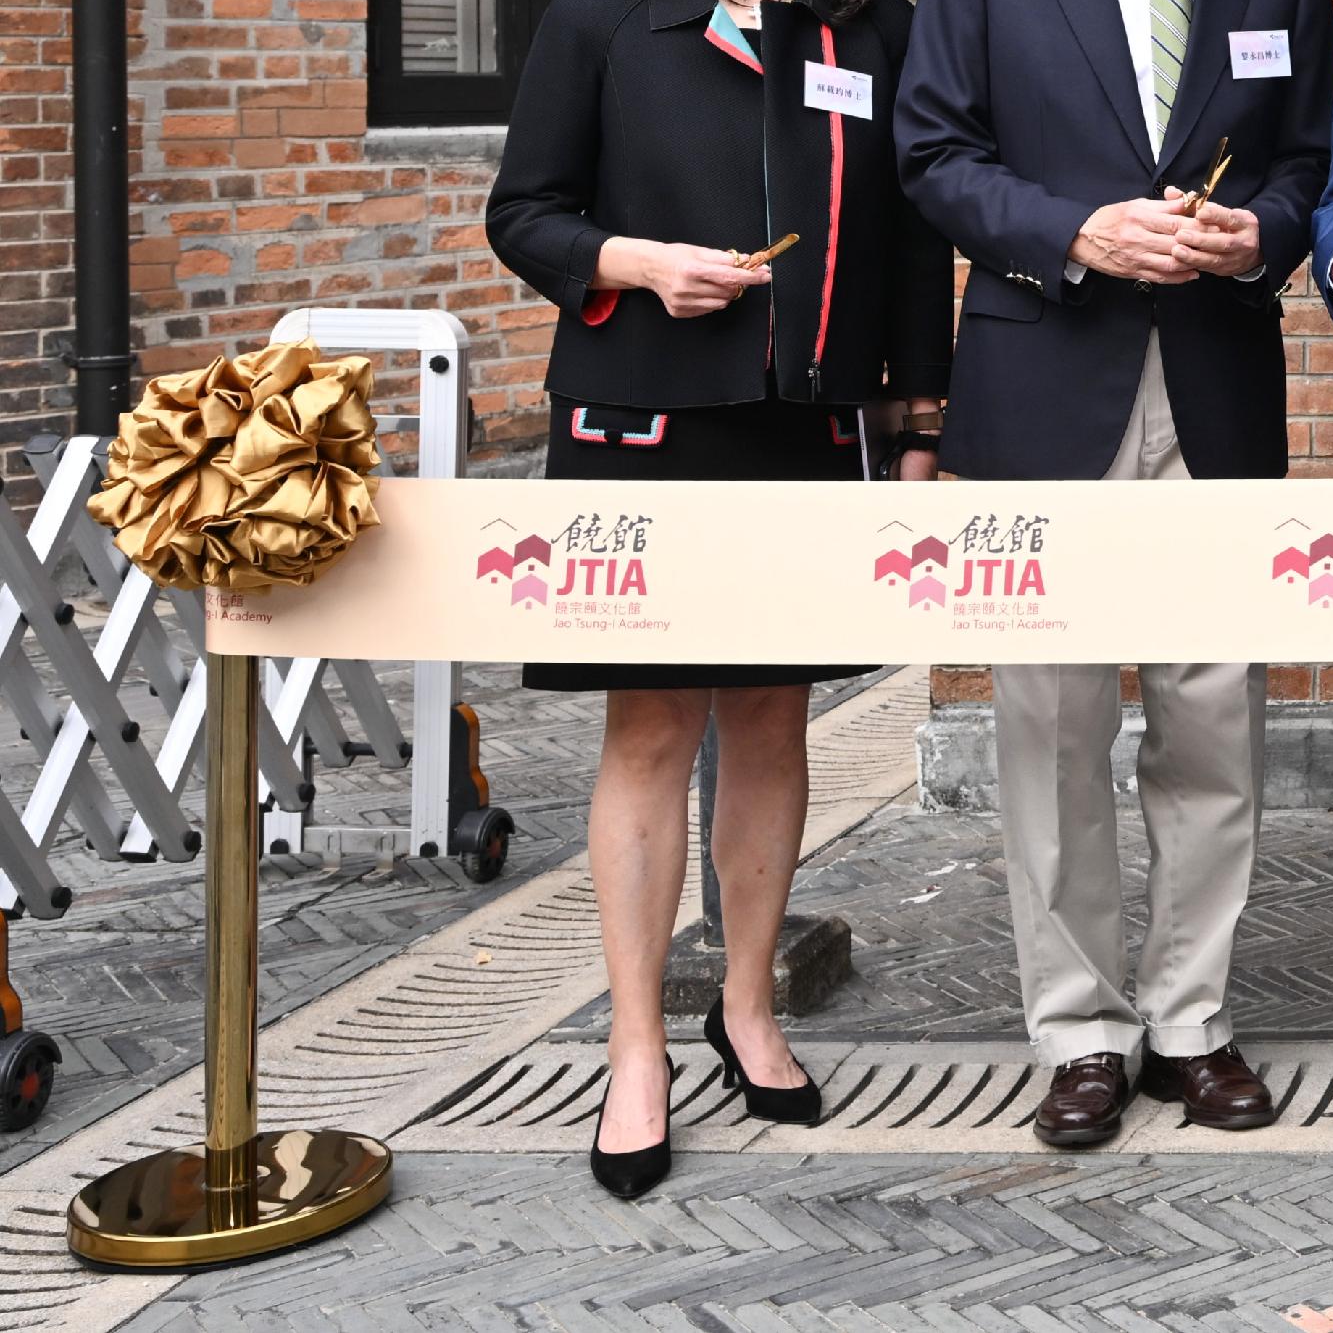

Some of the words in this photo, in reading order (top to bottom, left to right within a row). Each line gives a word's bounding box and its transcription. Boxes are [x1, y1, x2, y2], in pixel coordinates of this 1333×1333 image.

[556, 559, 648, 596] JTIA
[954, 559, 1046, 596] JTIA
[221, 610, 273, 624] Academy
[553, 617, 572, 629] Jao
[619, 618, 670, 631] Academy
[952, 619, 970, 630] Jao
[1017, 619, 1068, 631] Academy
